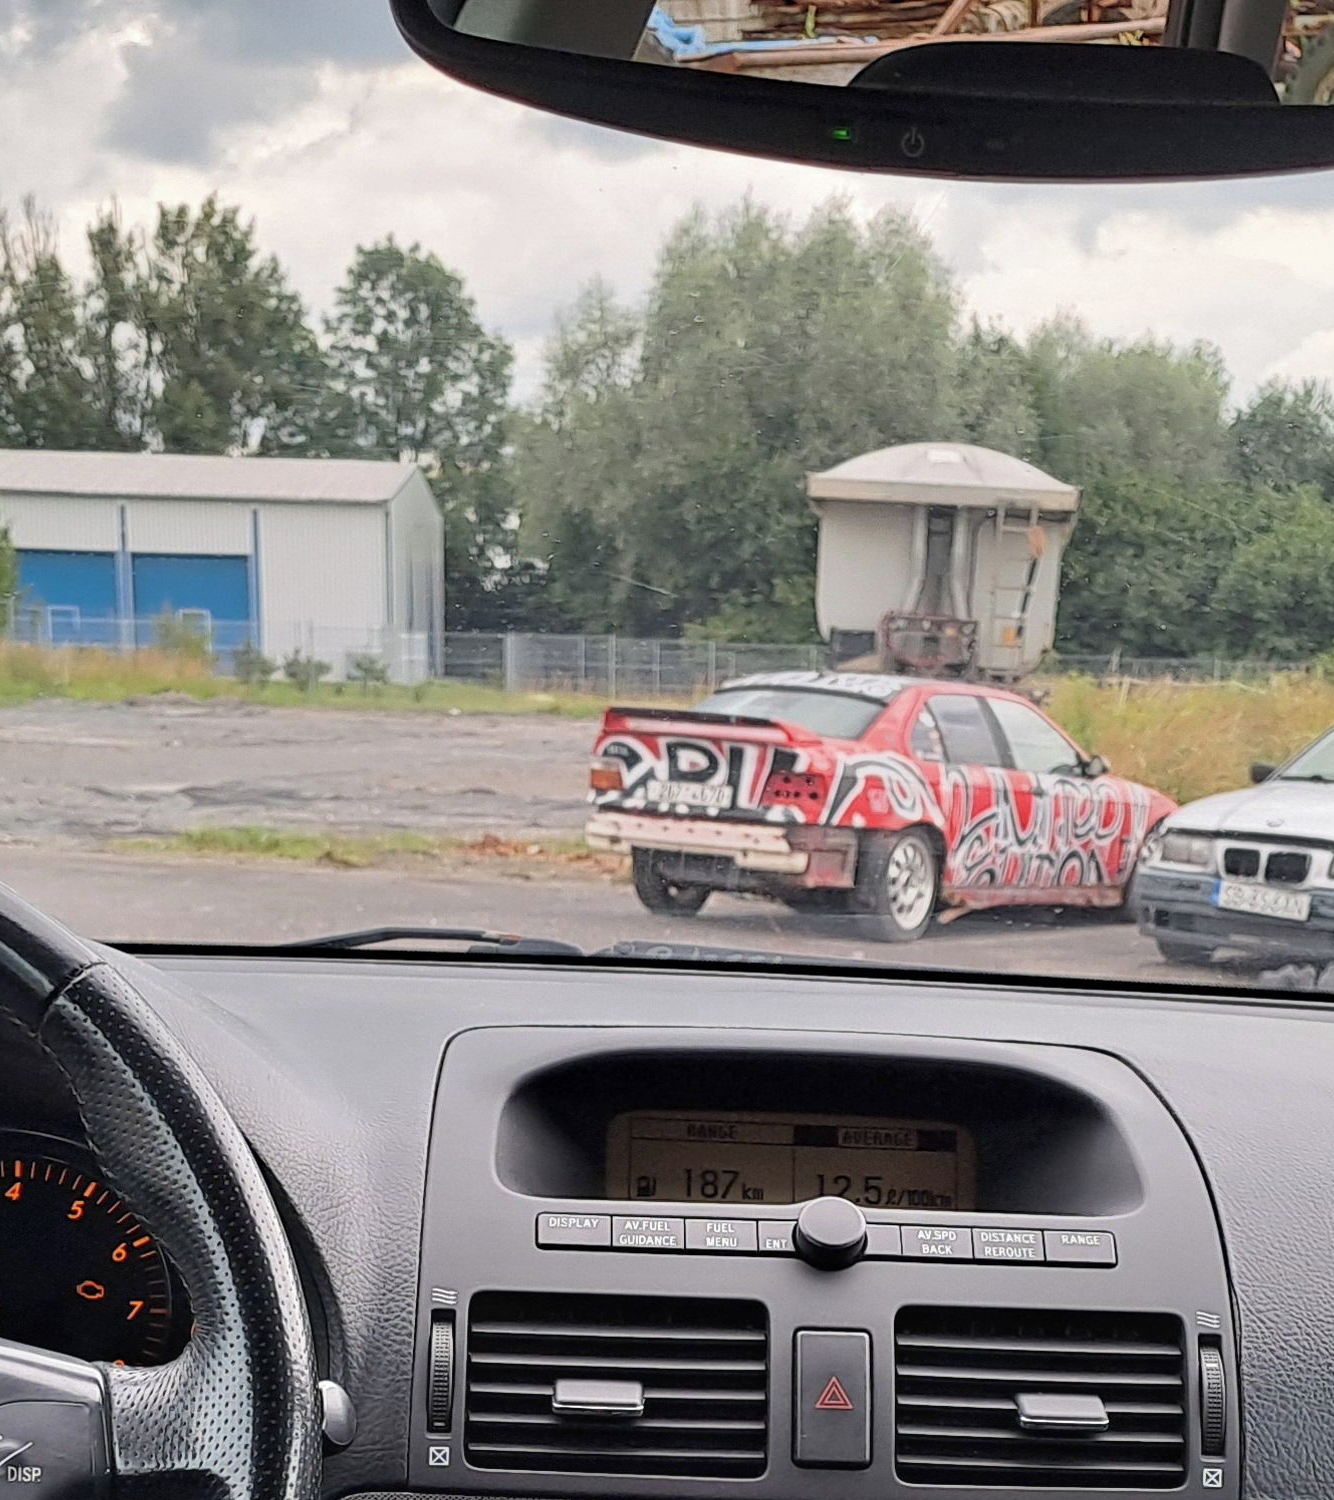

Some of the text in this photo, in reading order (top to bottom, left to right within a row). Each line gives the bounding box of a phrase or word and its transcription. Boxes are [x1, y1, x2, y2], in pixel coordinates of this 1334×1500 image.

[842, 1130, 913, 1147] AVERAGE
[5, 1182, 22, 1200] 4
[683, 1169, 764, 1201] 187 km
[67, 1200, 85, 1220] 5
[549, 1217, 599, 1229] DISPLAY
[624, 1220, 671, 1232] AV.FUEL
[706, 1223, 735, 1234] FUEL
[619, 1234, 677, 1247] GUIDANCE
[706, 1237, 738, 1248] MENU
[765, 1238, 788, 1250] ENT
[980, 1232, 1036, 1245] DISTANCE
[1061, 1235, 1100, 1246] RANGE
[112, 1243, 127, 1261] 6
[922, 1244, 954, 1256] BACK
[984, 1246, 1036, 1258] REROUTE
[127, 1301, 144, 1320] 7
